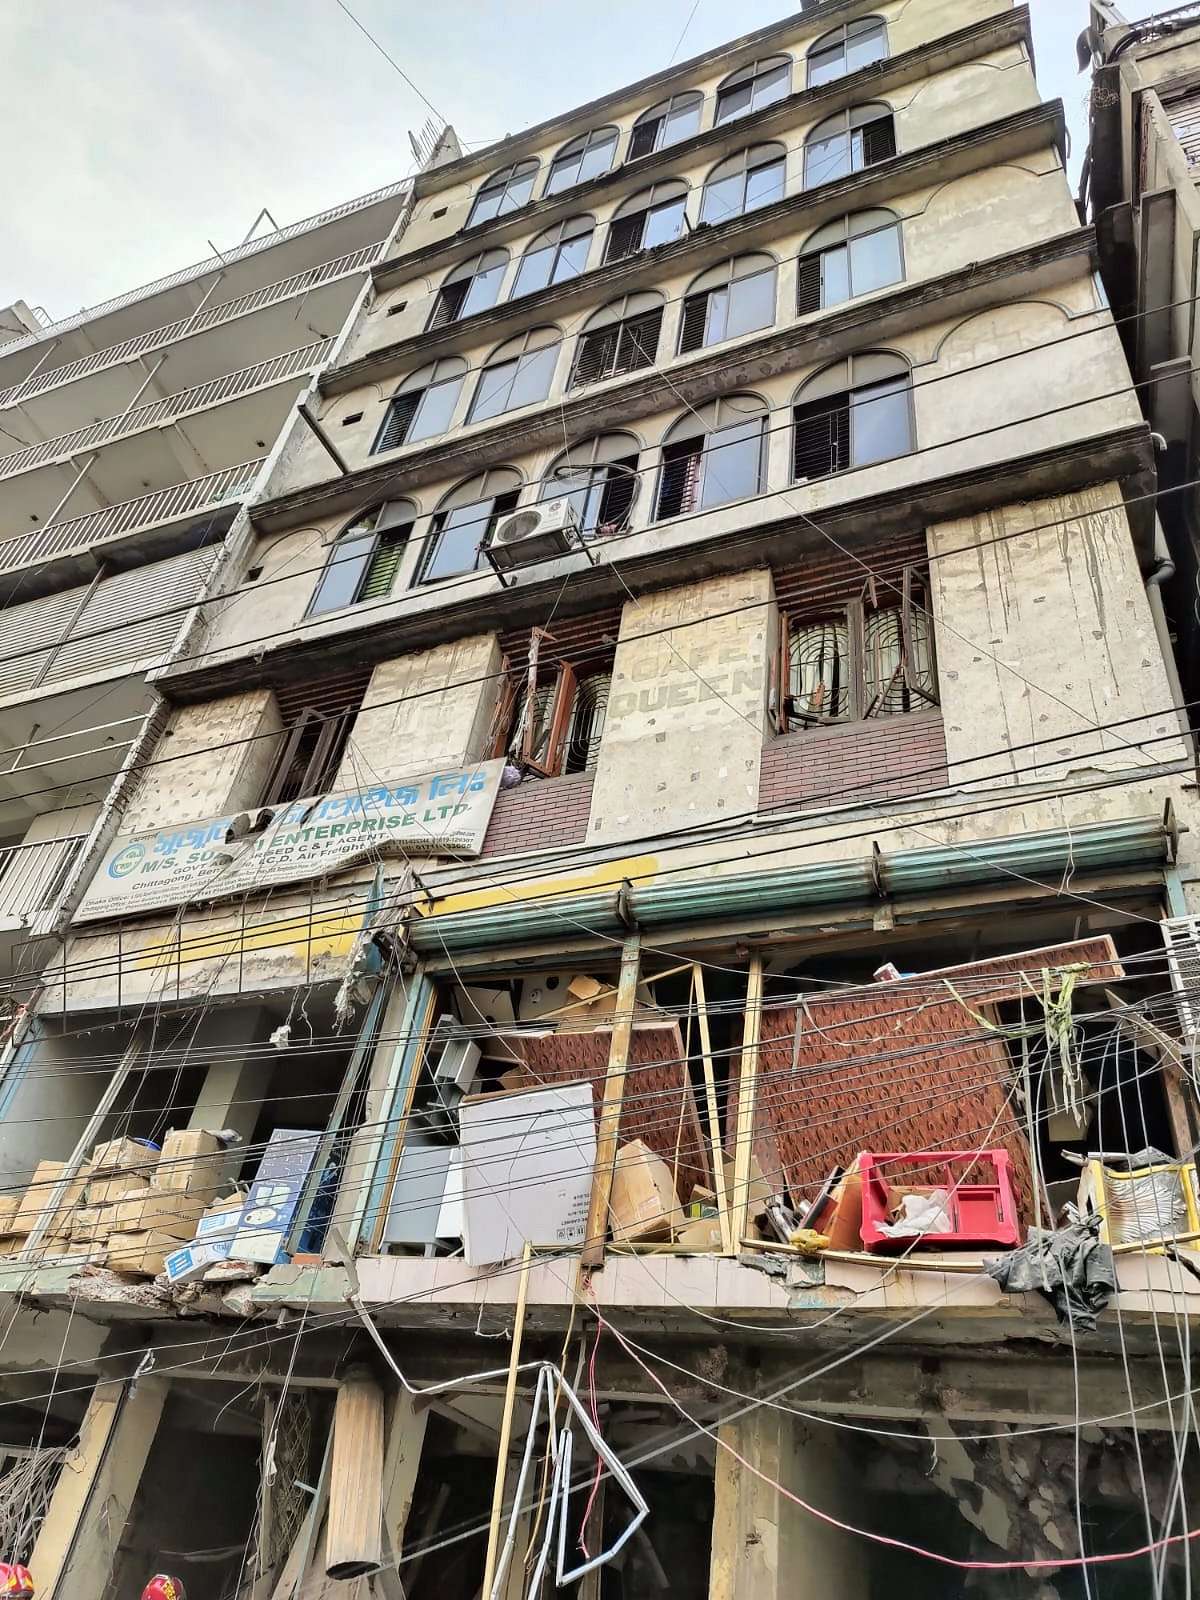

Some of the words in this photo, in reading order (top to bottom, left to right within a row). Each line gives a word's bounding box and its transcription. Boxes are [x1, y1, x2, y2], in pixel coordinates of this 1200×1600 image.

[608, 667, 763, 719] QUEEN
[270, 812, 417, 848] ENTERPRISE
[297, 852, 317, 861] Air
[319, 841, 366, 857] Freight
[298, 844, 308, 852] C
